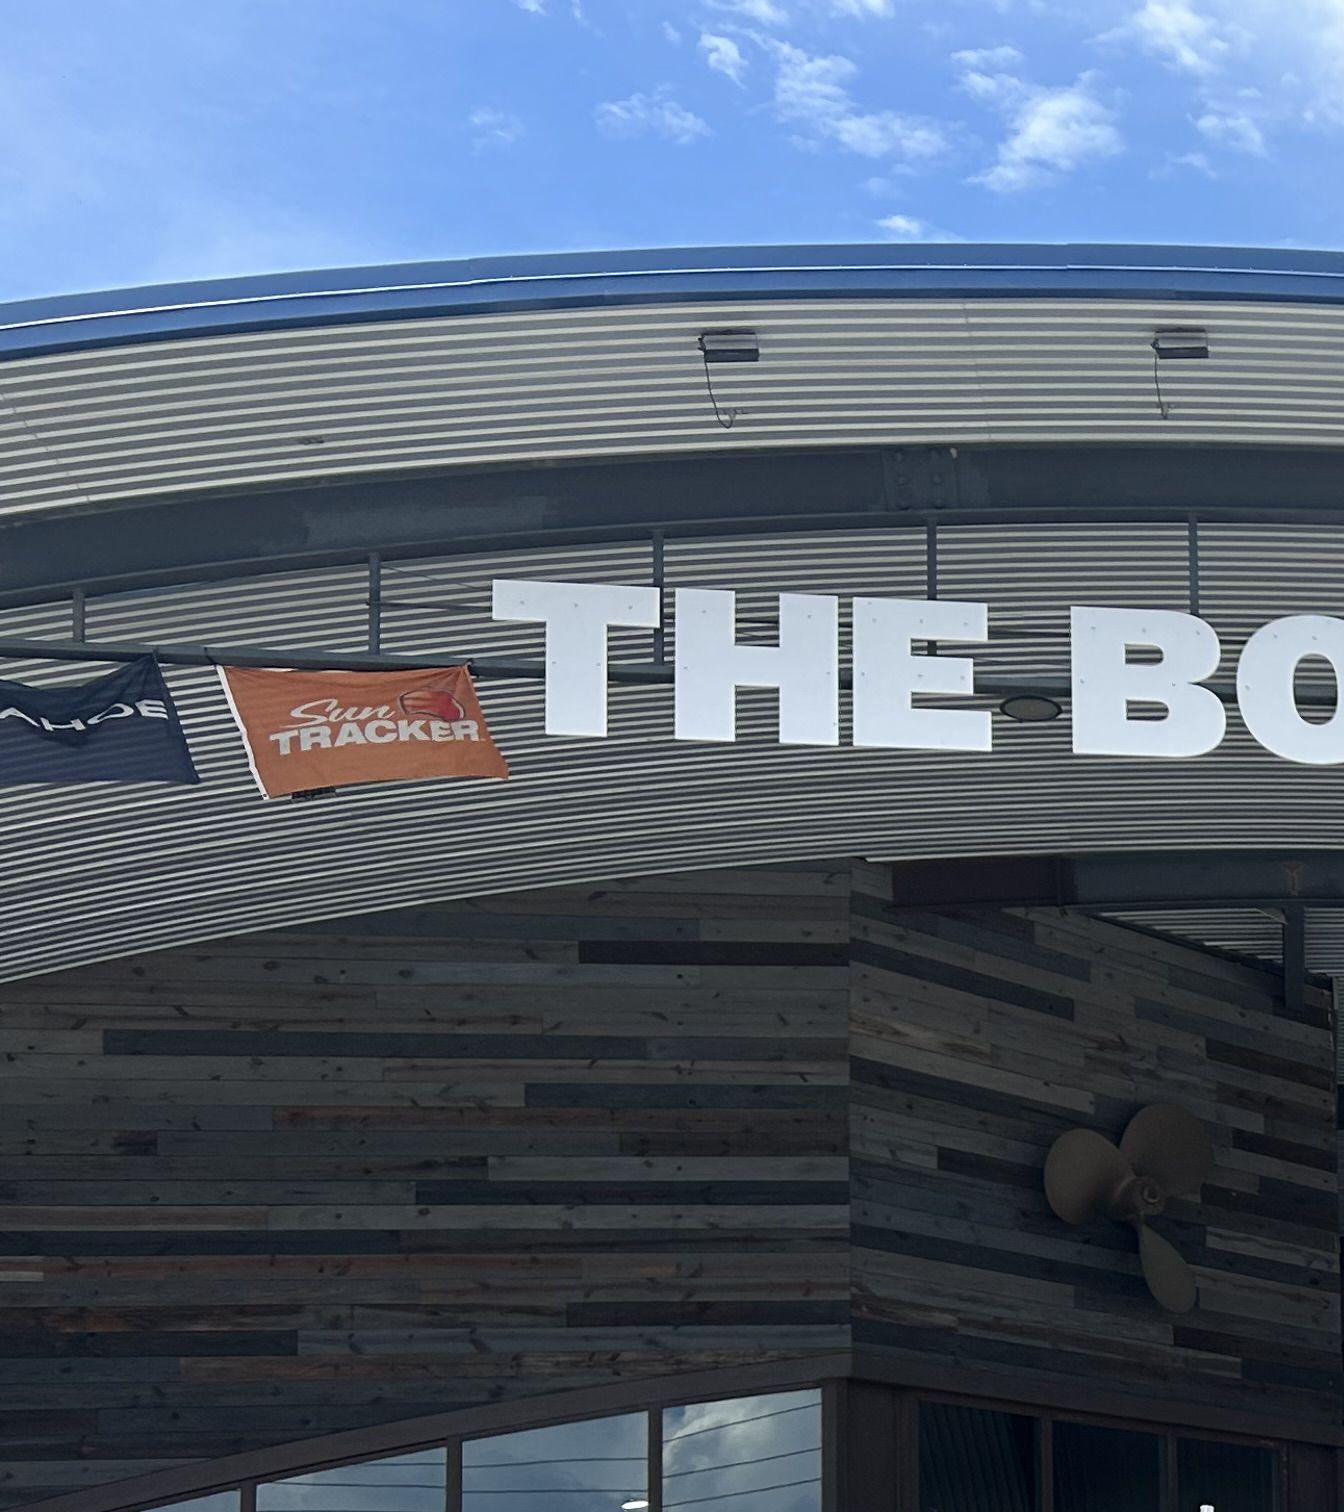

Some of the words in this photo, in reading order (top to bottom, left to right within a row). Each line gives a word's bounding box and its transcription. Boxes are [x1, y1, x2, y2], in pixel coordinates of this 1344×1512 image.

[492, 578, 993, 752] THE
[280, 698, 397, 729] Sun
[269, 719, 480, 756] TRACKER
